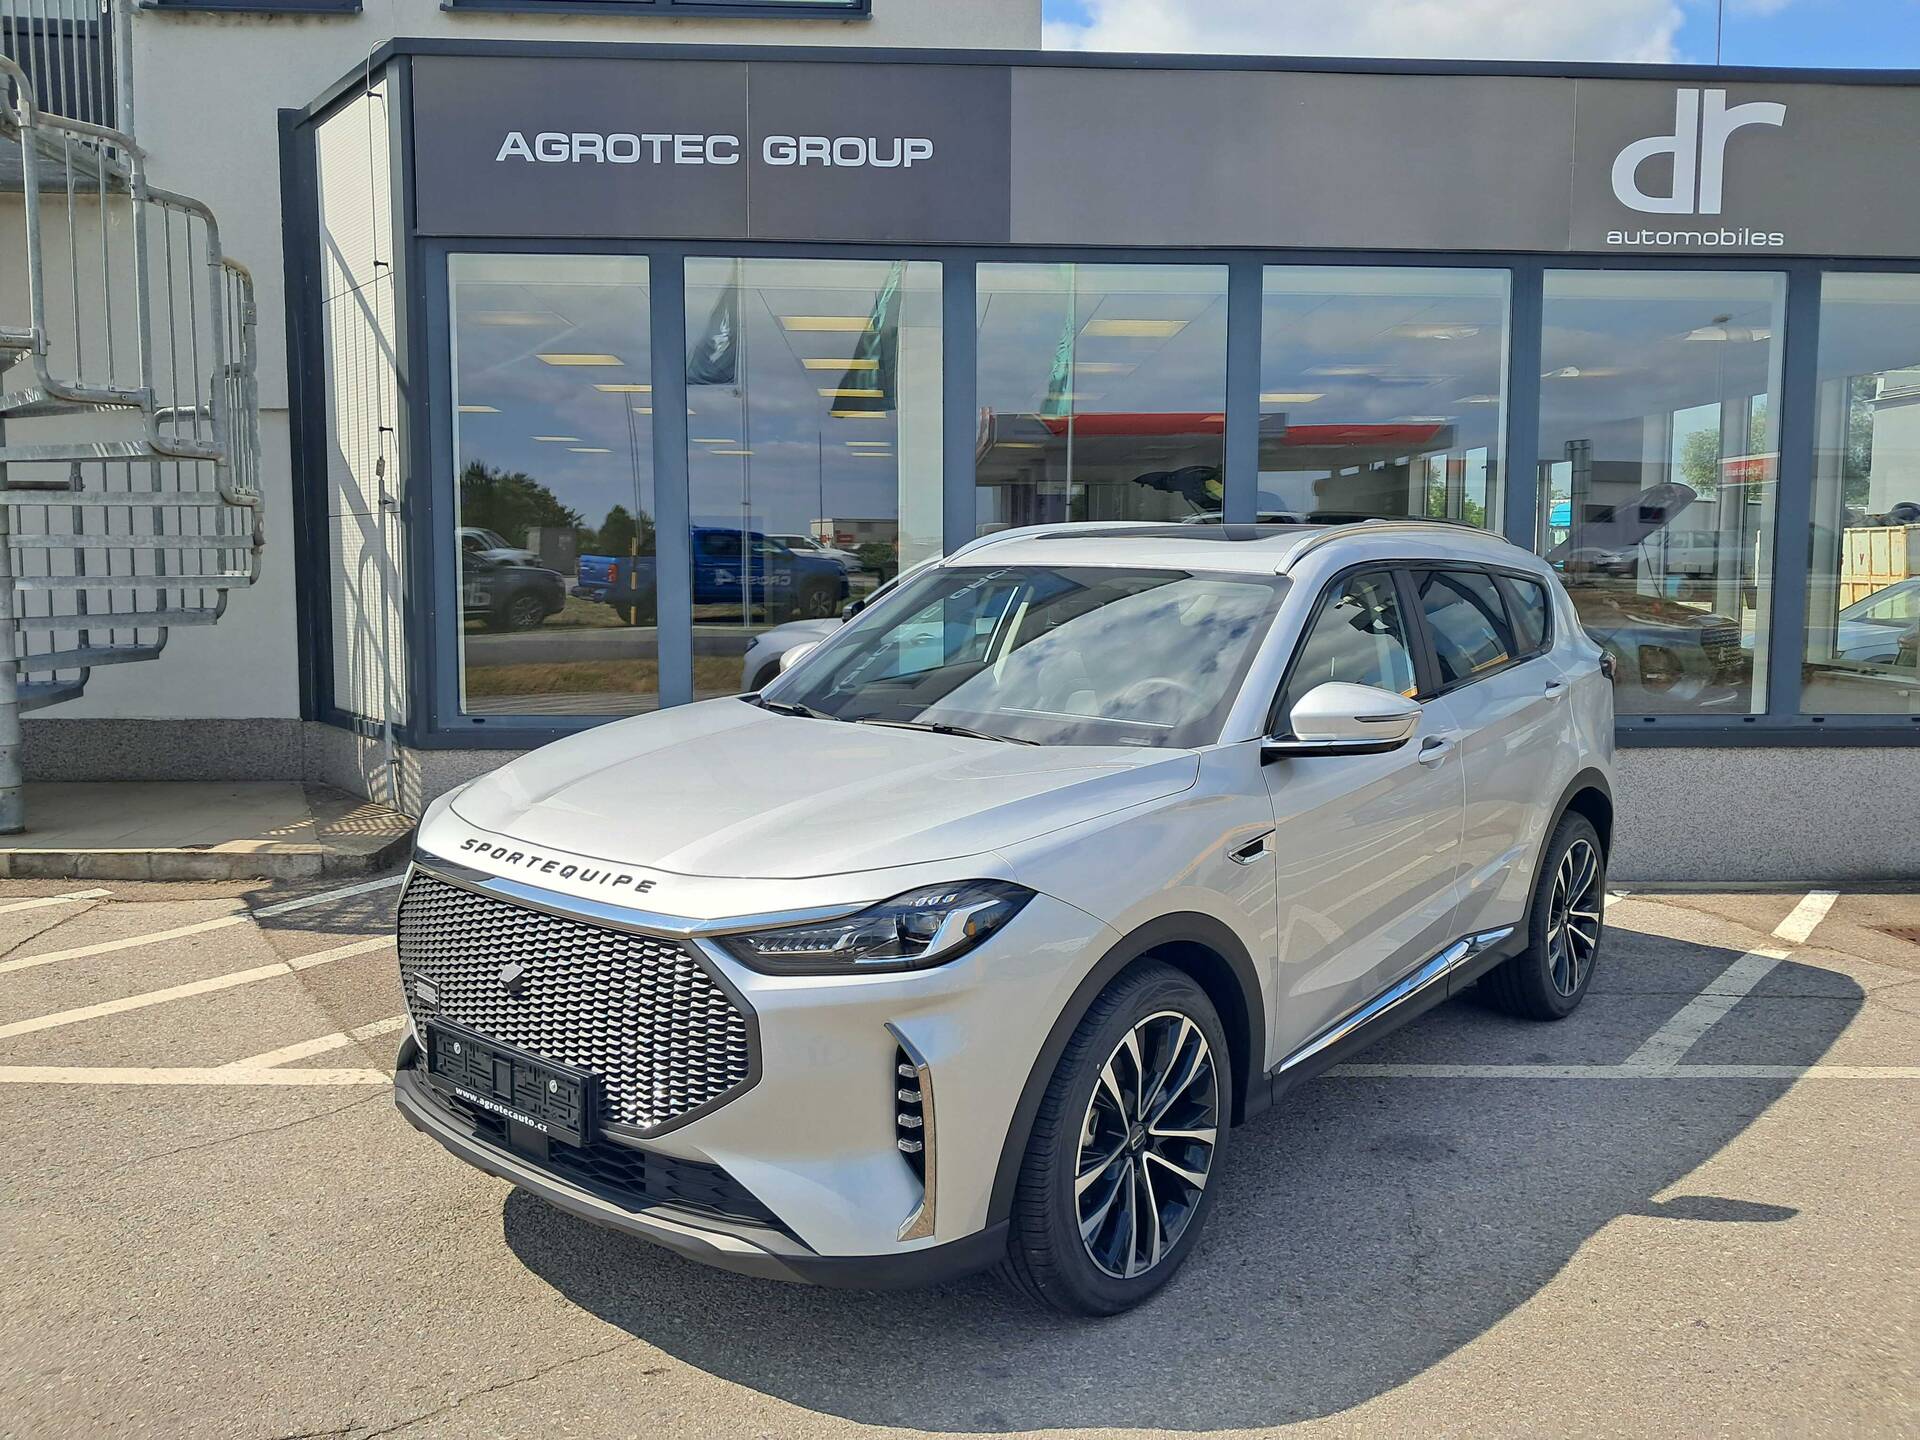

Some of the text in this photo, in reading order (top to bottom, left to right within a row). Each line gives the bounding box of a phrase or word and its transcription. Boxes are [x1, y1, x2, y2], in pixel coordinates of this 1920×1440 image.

[495, 131, 935, 168] AGROTEC GROUP
[1611, 88, 1787, 215] dr
[1606, 227, 1785, 247] automobiles
[460, 838, 657, 894] SPORTEQUIPE
[455, 1086, 548, 1133] www.agrotecauto.cz
